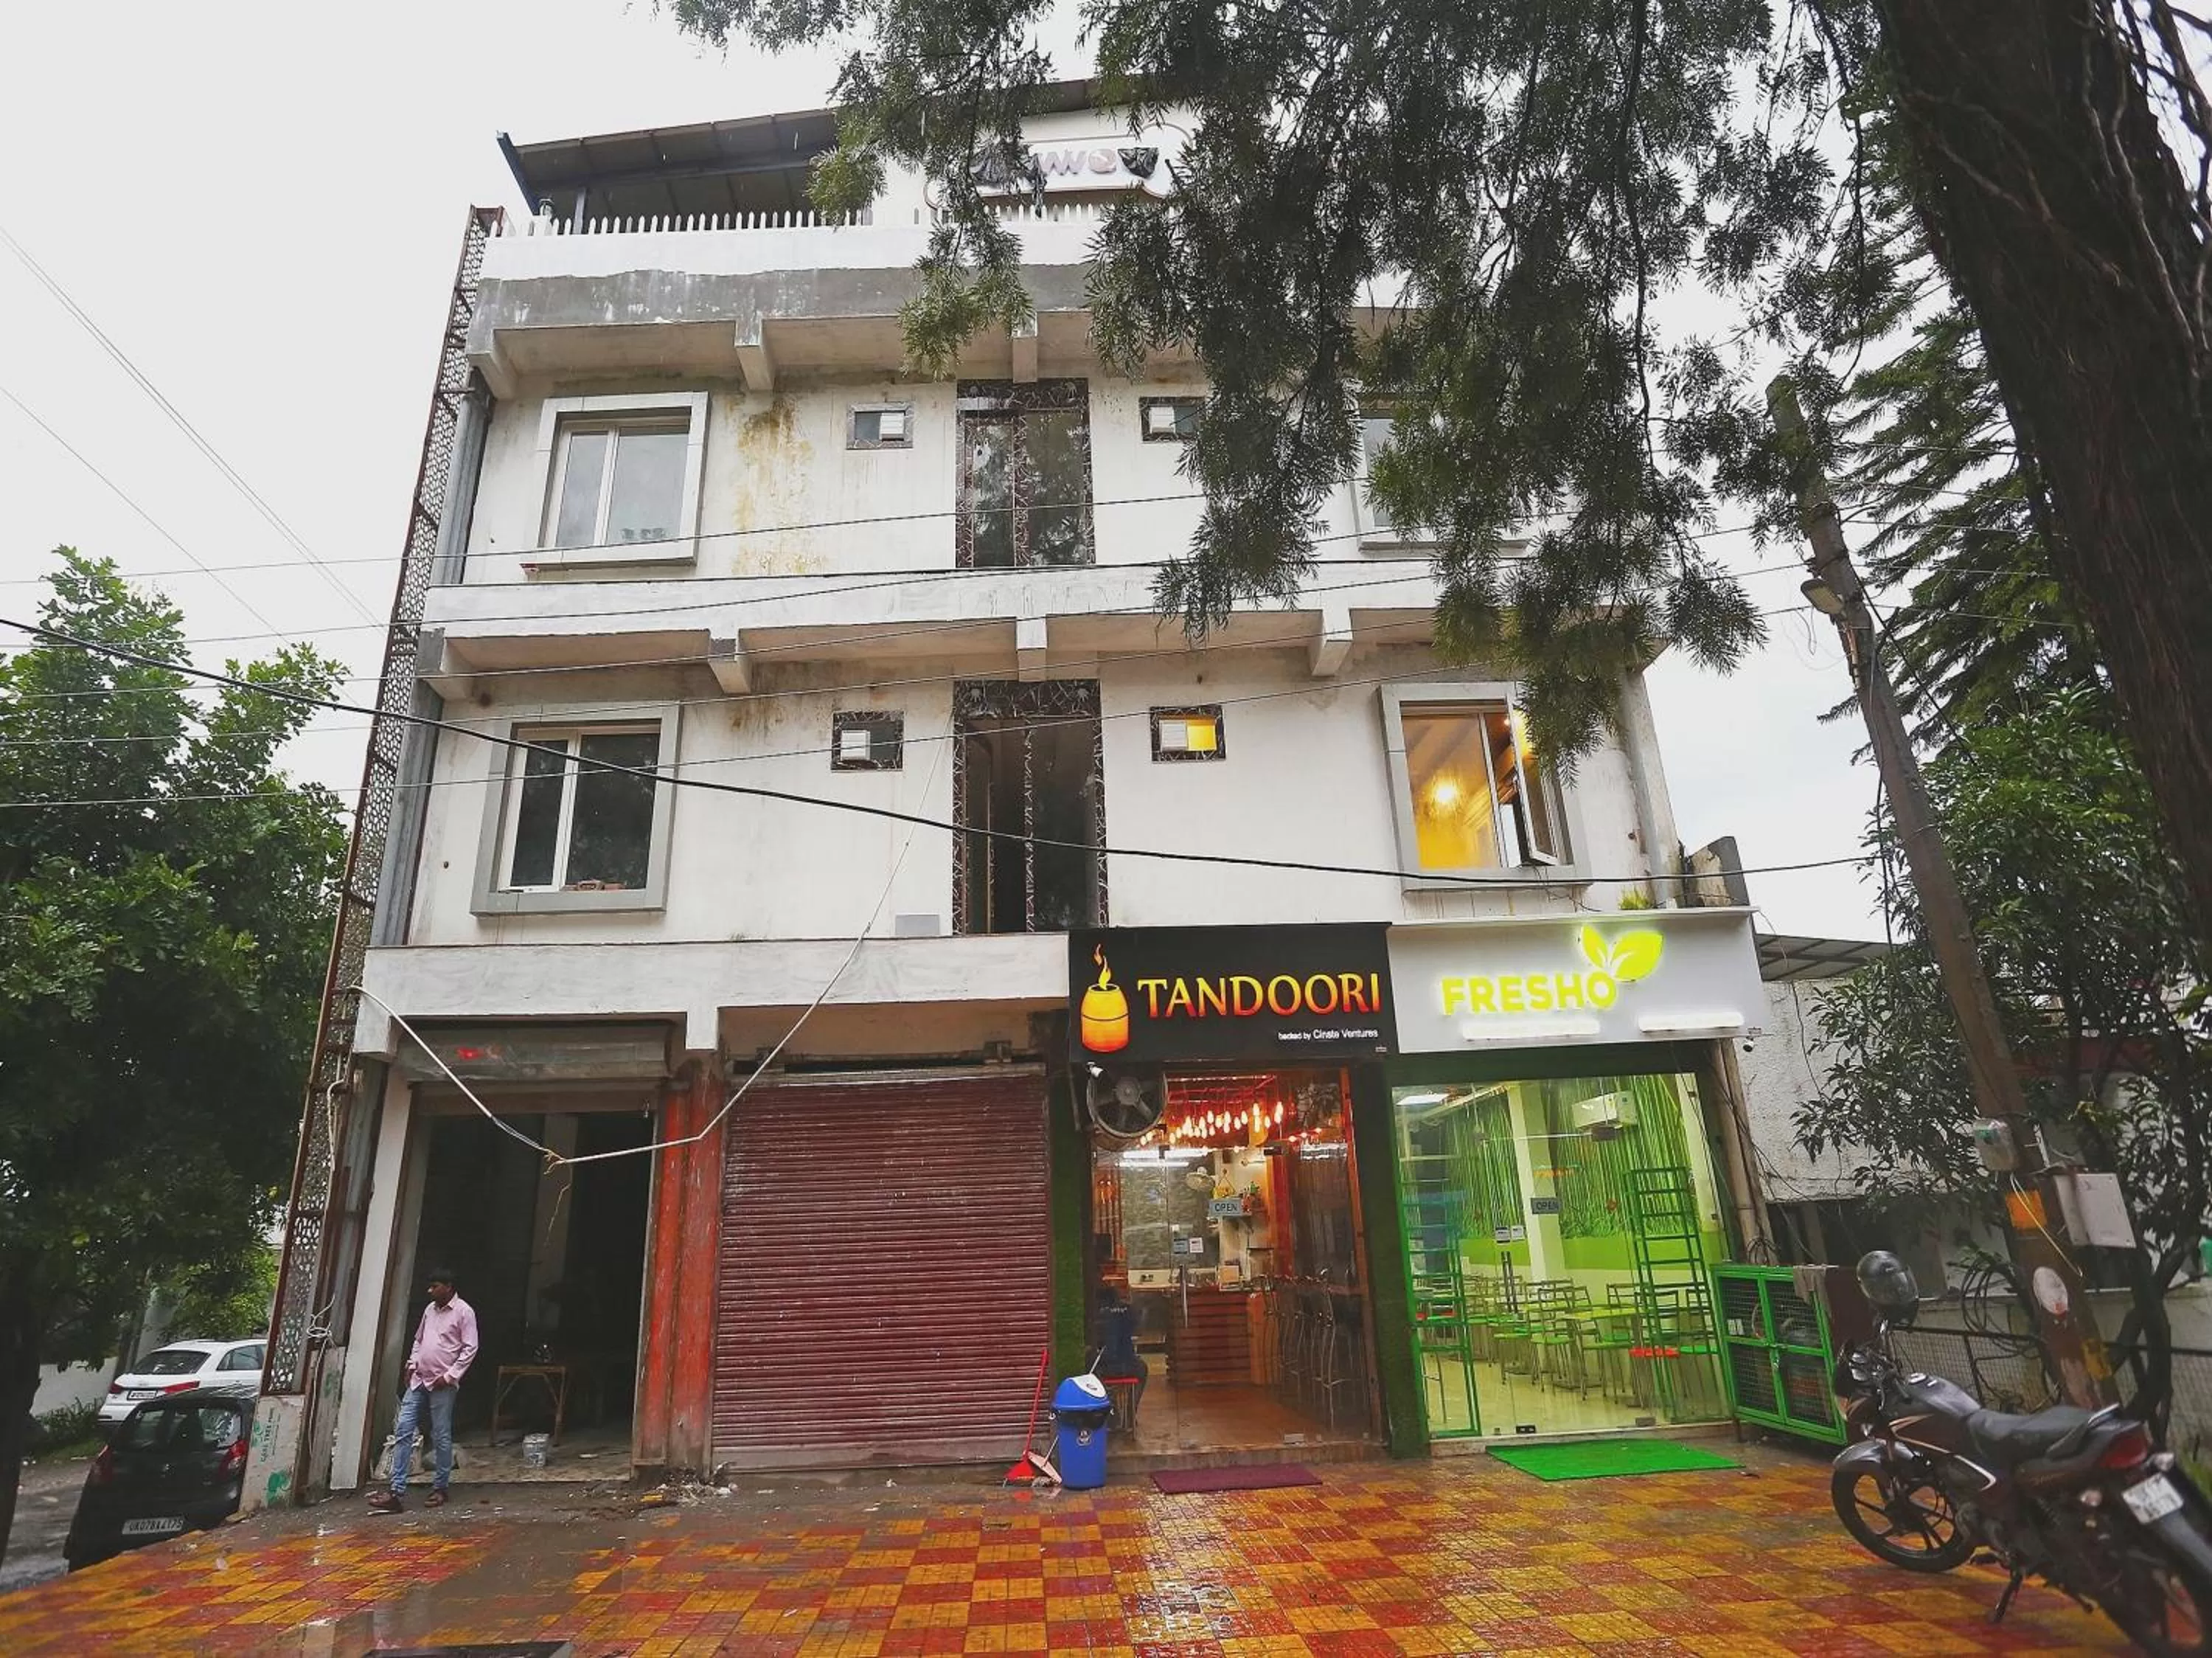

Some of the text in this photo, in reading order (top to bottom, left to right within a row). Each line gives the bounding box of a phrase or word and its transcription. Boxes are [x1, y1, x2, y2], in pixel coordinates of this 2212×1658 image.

[1138, 973, 1380, 1019] TANDOORI
[1441, 970, 1618, 1016] FRESHO
[1303, 1031, 1312, 1041] by
[1341, 1028, 1379, 1038] Ventures
[1214, 1203, 1238, 1212] OPEN
